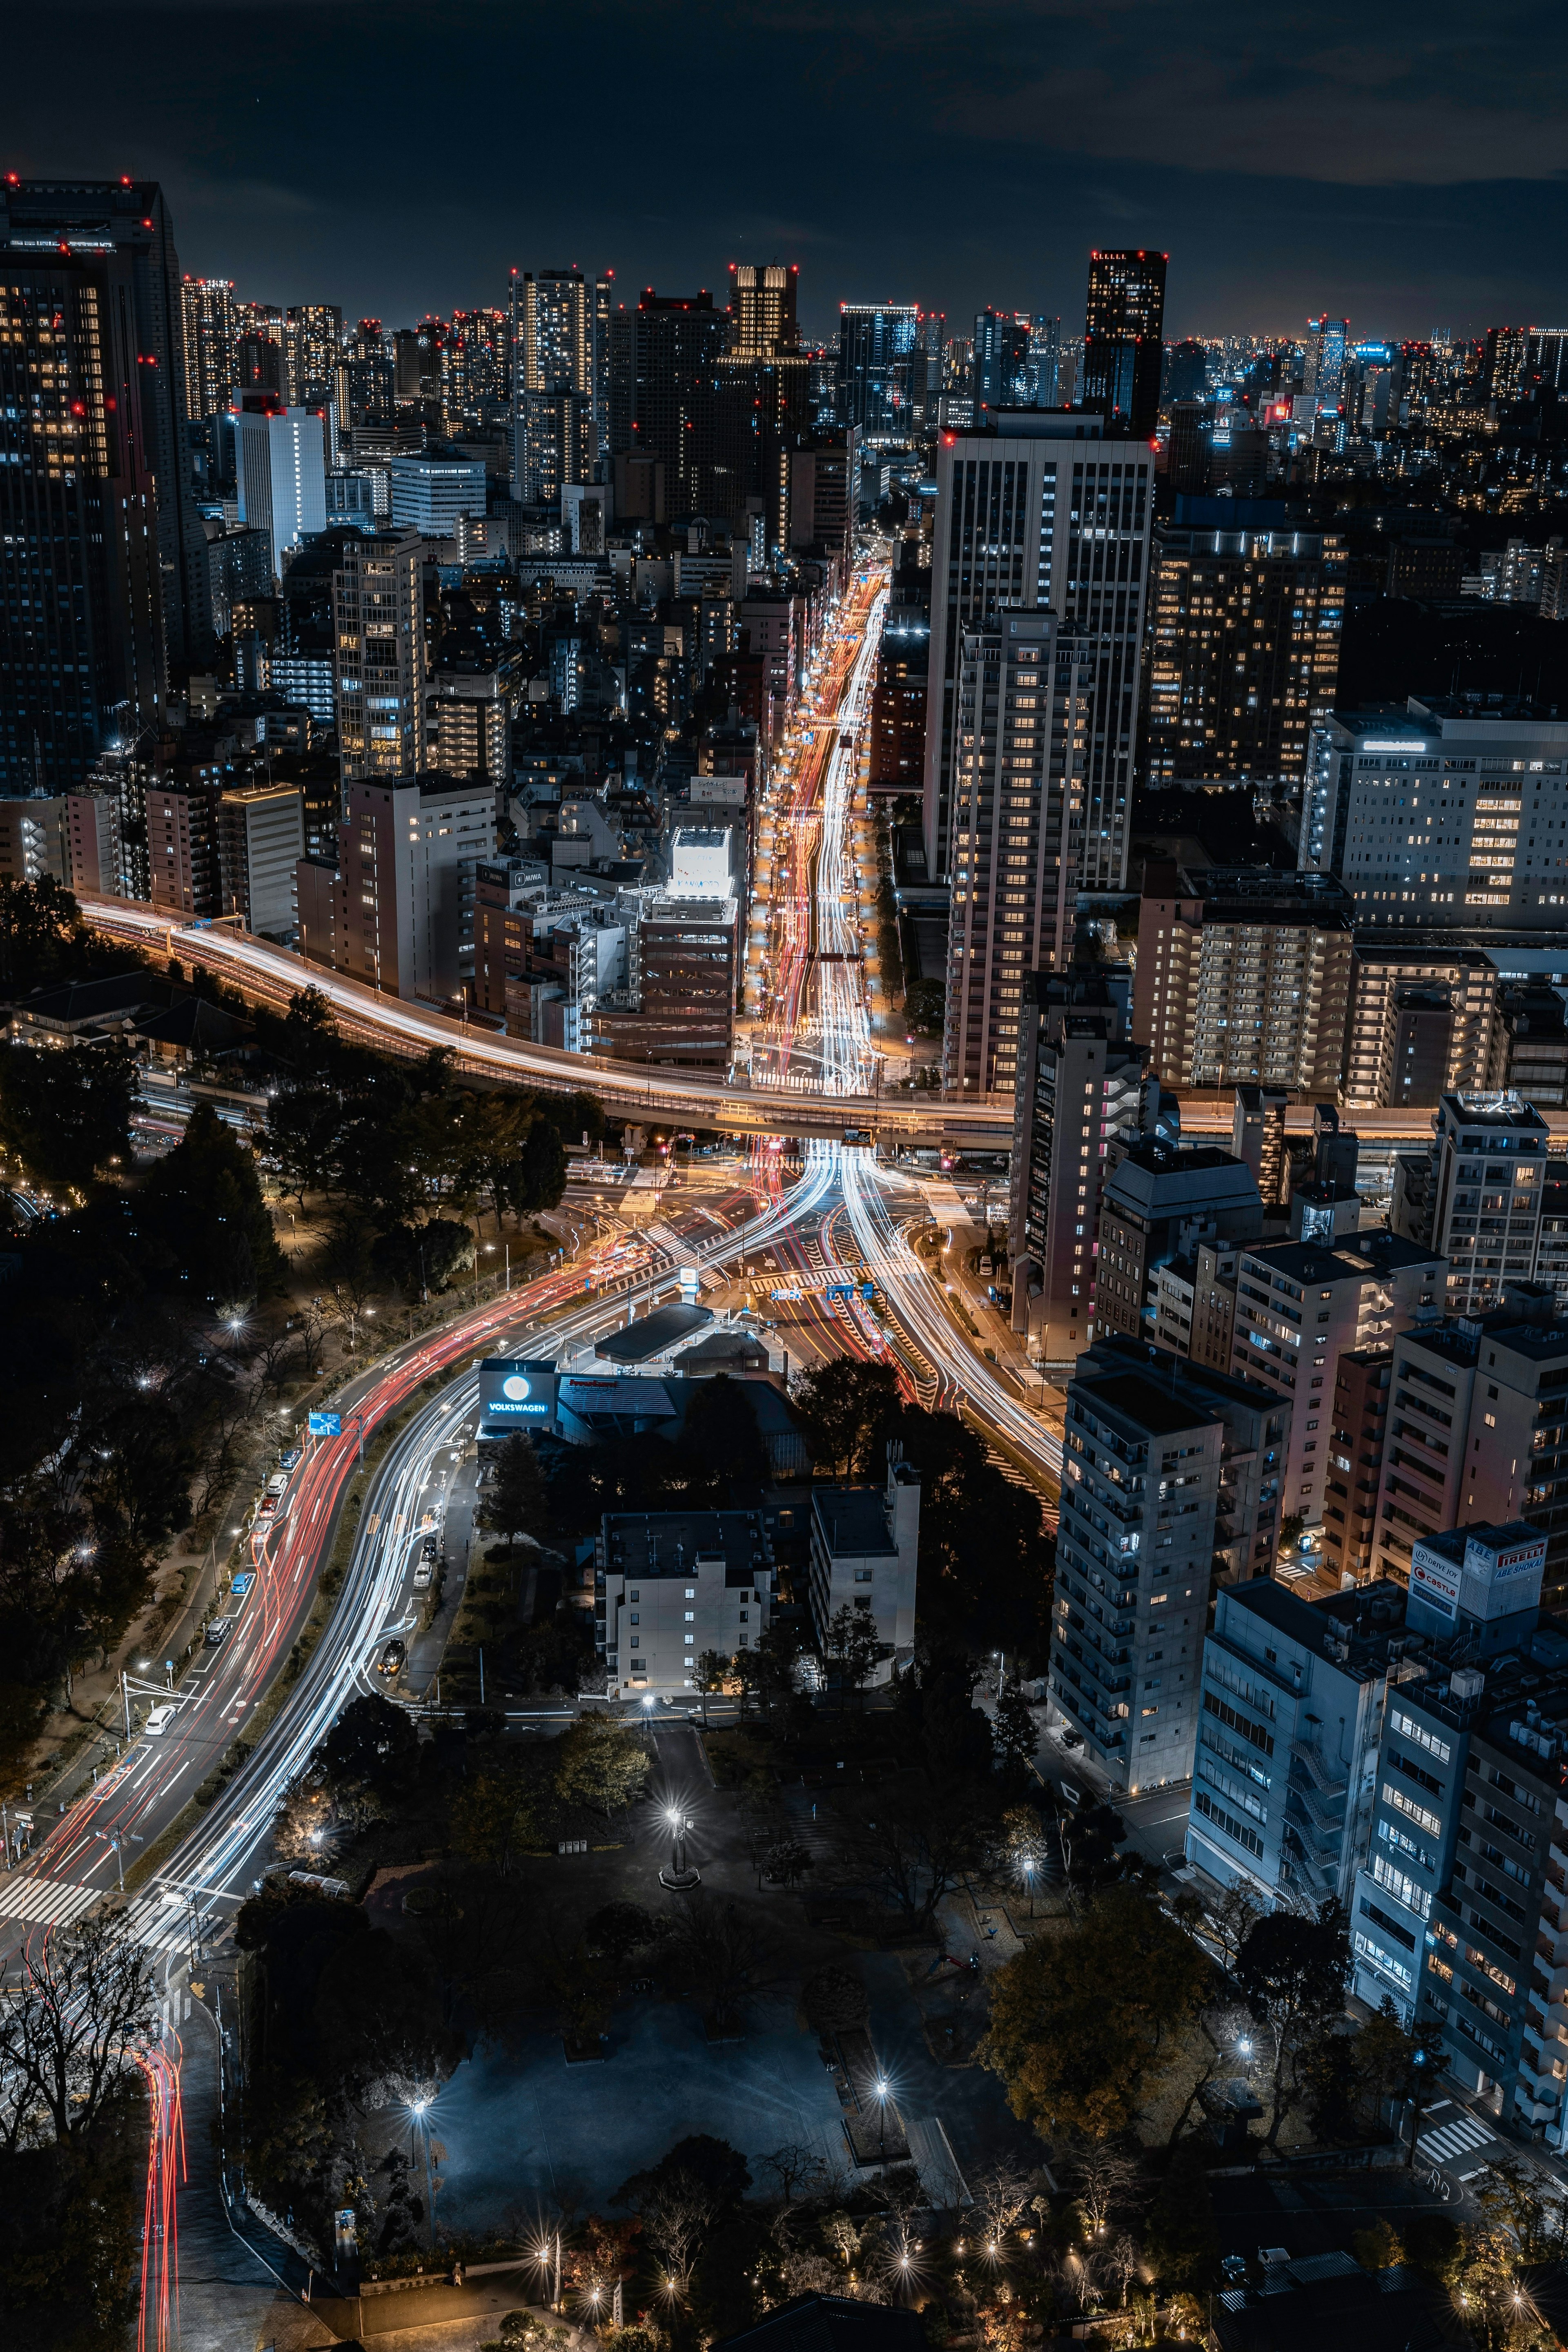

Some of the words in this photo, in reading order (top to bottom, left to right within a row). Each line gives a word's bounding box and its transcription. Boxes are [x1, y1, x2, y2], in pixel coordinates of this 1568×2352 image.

[490, 873, 502, 882] MIWA
[525, 873, 542, 882] MIWA
[489, 1403, 545, 1412] VOLKSWAGEN
[1467, 1541, 1492, 1560] ABE
[1497, 1543, 1545, 1568] PIRELLI
[1428, 1559, 1446, 1572] DRIVE
[1446, 1569, 1458, 1579] JOY
[1495, 1568, 1512, 1579] ABE
[1513, 1559, 1543, 1574] SHOKAI
[1414, 1587, 1451, 1613] GOODYEAR
